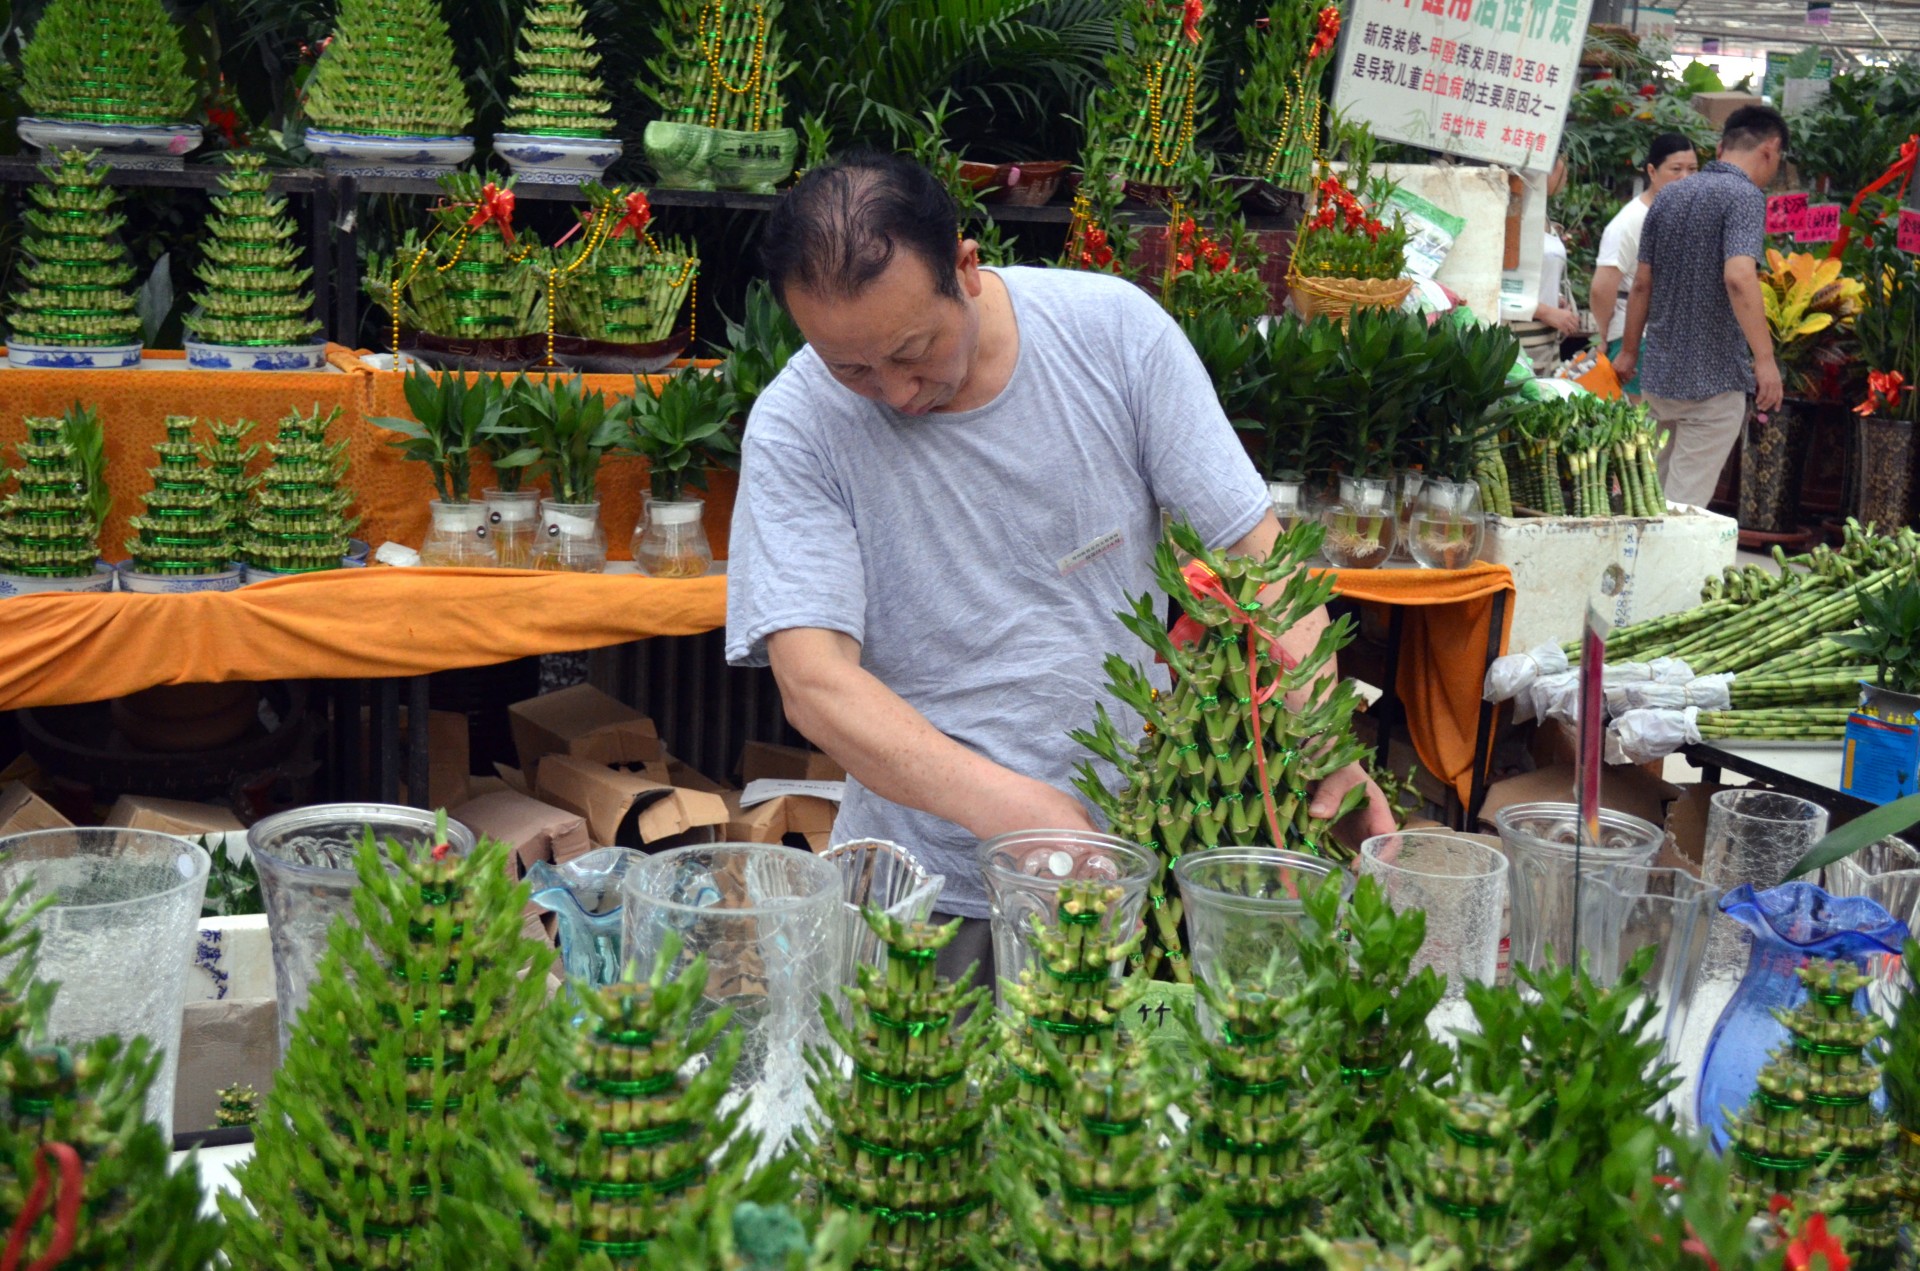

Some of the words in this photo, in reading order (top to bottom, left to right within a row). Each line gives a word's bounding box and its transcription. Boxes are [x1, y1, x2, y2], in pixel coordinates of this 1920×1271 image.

[1352, 53, 1556, 117] 是导致儿童白血病的主要原因之一
[1440, 112, 1487, 140] 活性竹炭
[1500, 124, 1548, 152] 本店有售
